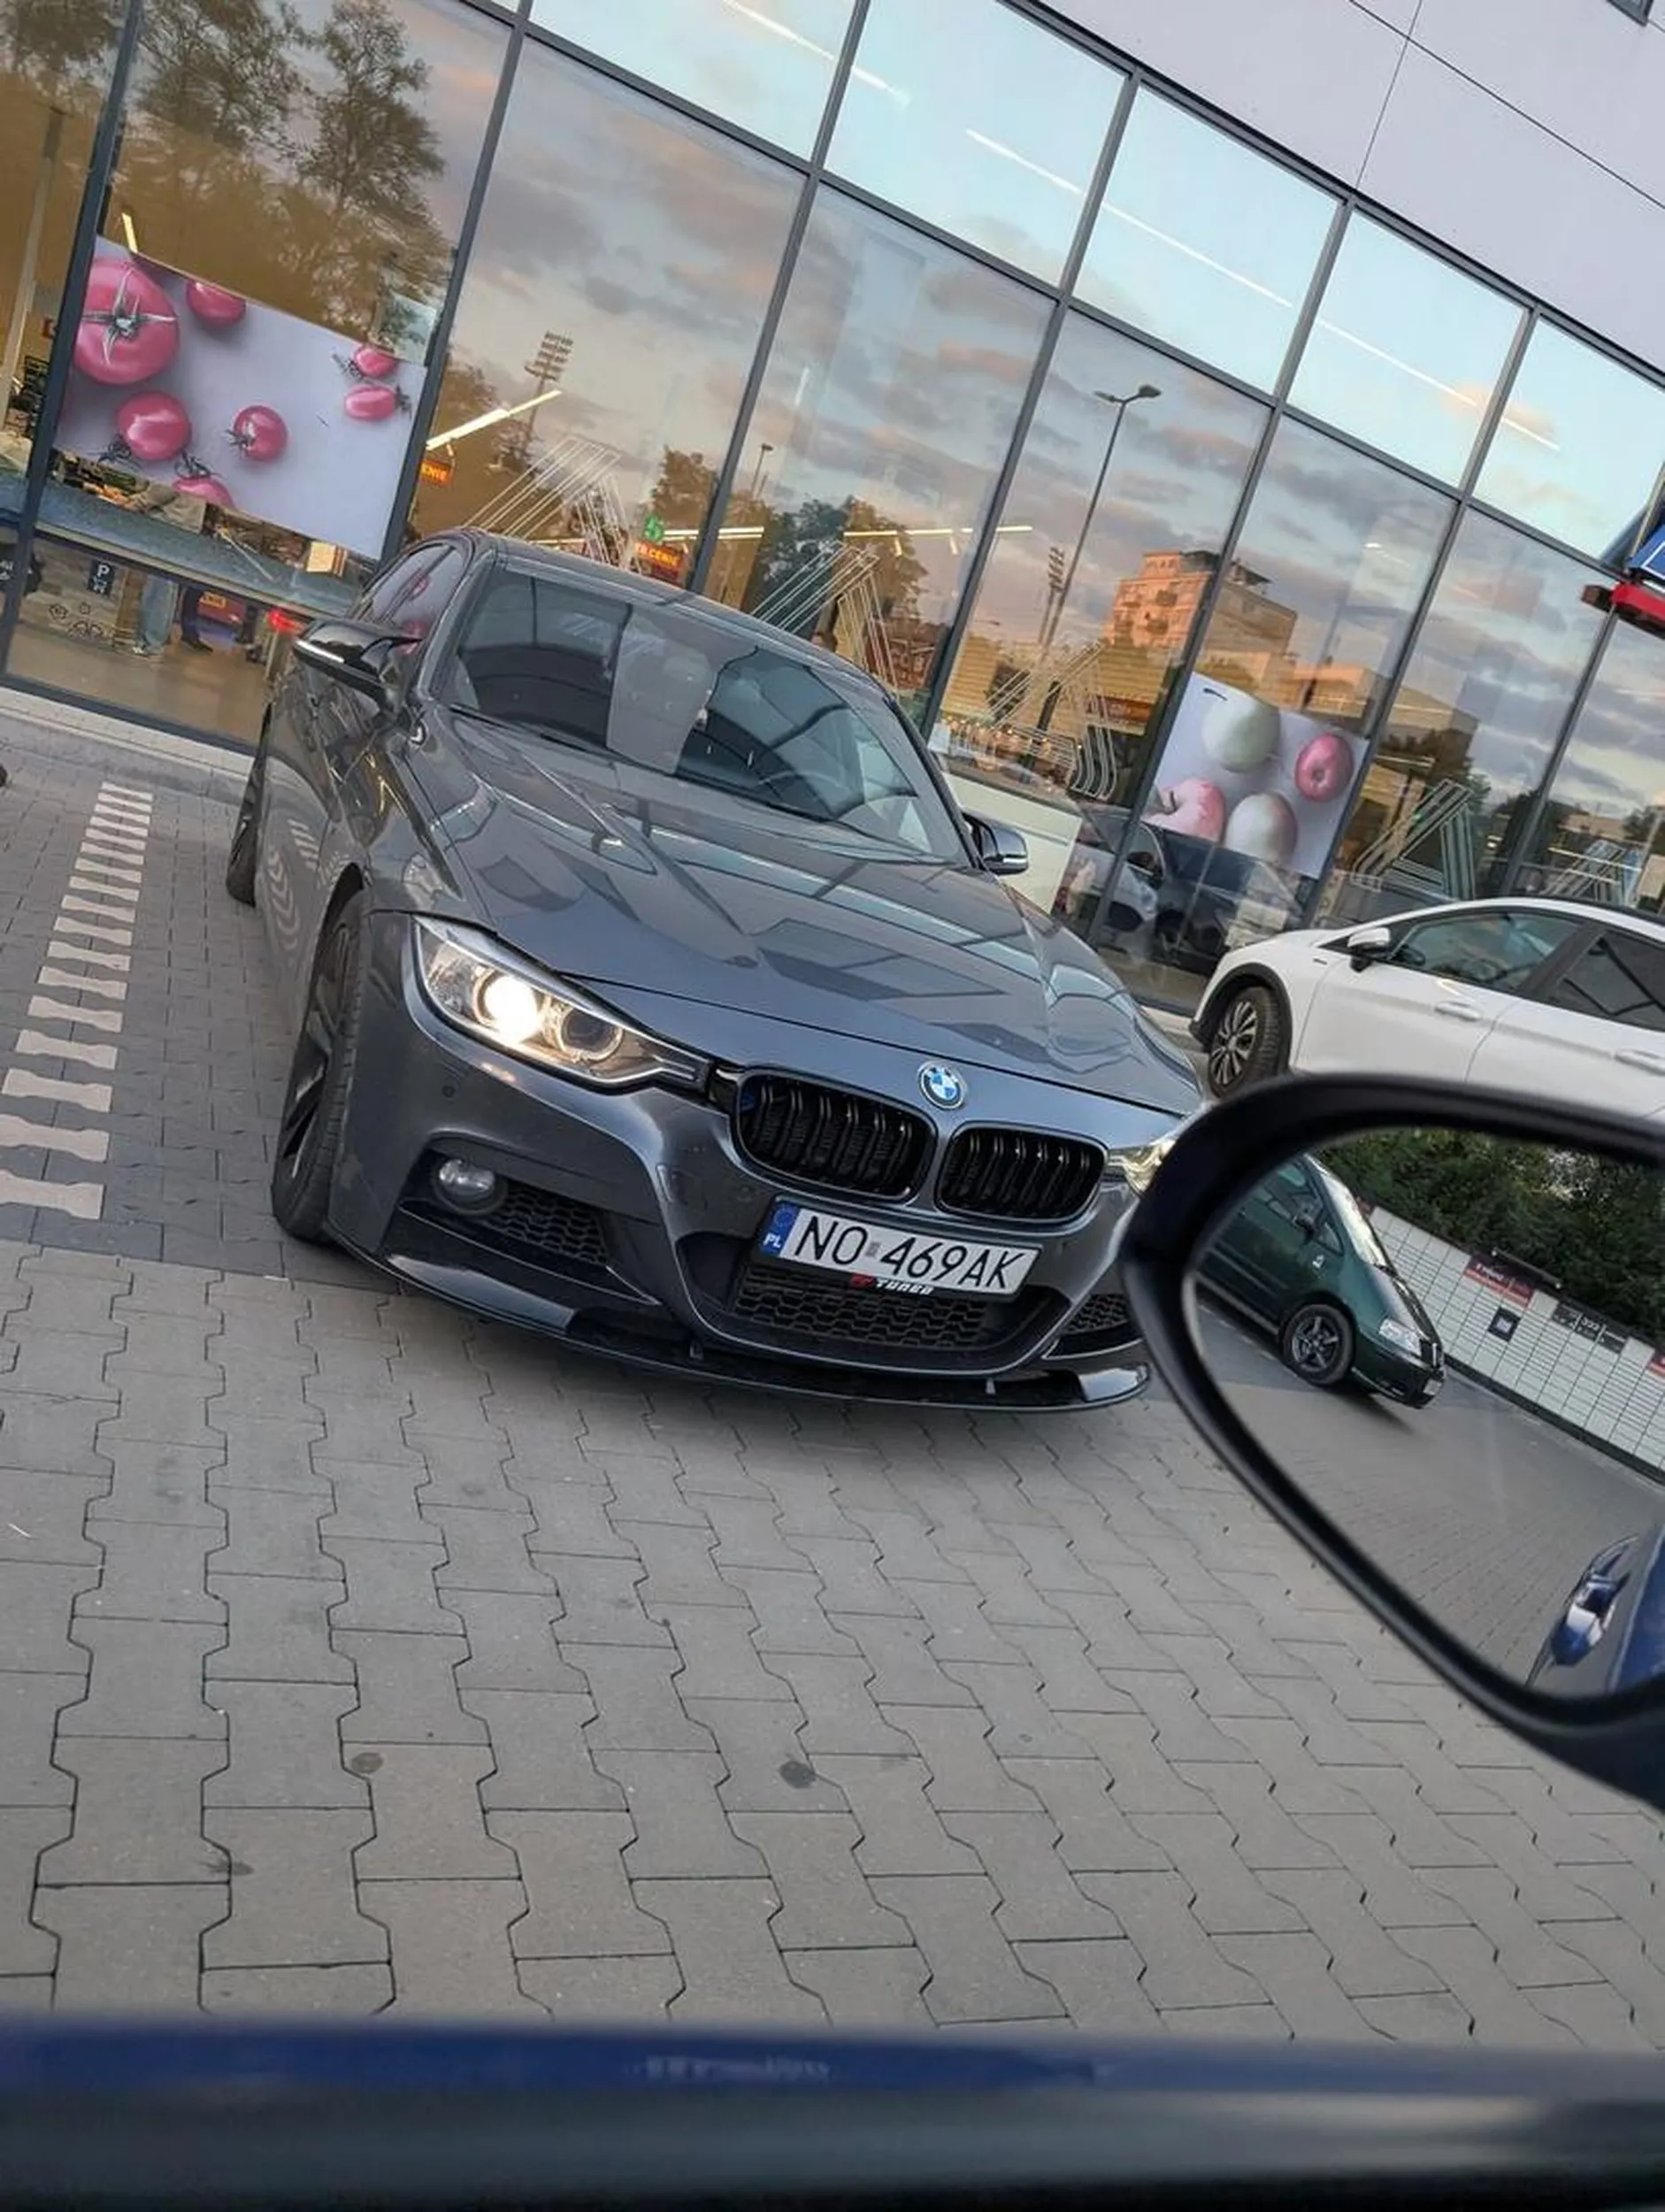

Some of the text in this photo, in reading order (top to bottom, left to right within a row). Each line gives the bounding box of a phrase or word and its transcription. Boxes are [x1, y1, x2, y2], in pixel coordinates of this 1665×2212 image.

[763, 1233, 781, 1248] PL
[795, 1215, 1025, 1289] NO 469AK
